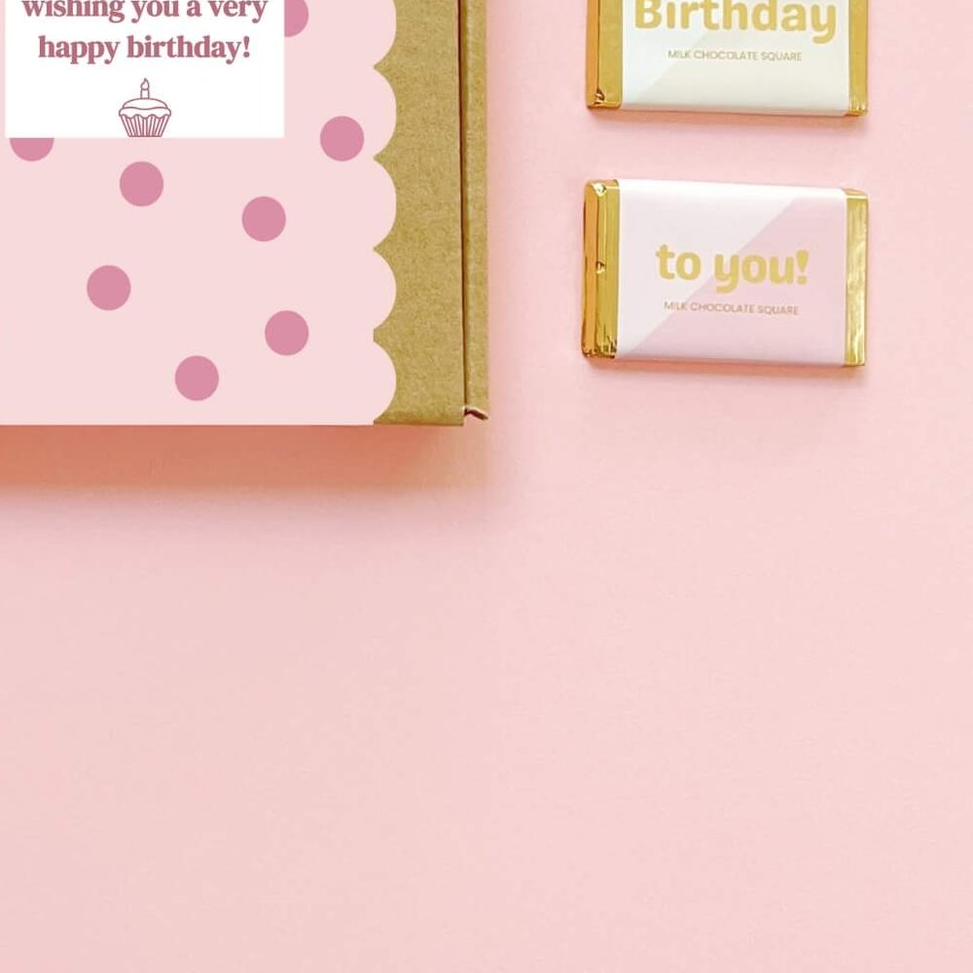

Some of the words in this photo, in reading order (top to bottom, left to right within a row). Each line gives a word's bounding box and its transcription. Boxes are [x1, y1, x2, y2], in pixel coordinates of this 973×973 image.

[130, 0, 180, 24] you
[186, 0, 202, 17] a
[207, 0, 269, 24] very
[38, 35, 121, 65] happy
[126, 35, 251, 65] birthday!
[667, 49, 691, 60] MILK
[693, 50, 758, 61] CHOCOLATE
[761, 51, 803, 62] SQUARE
[655, 244, 702, 281] to
[714, 249, 810, 294] you!
[663, 301, 686, 312] MILK
[690, 302, 756, 314] CHOCOLATE
[757, 304, 800, 316] SQUARE
